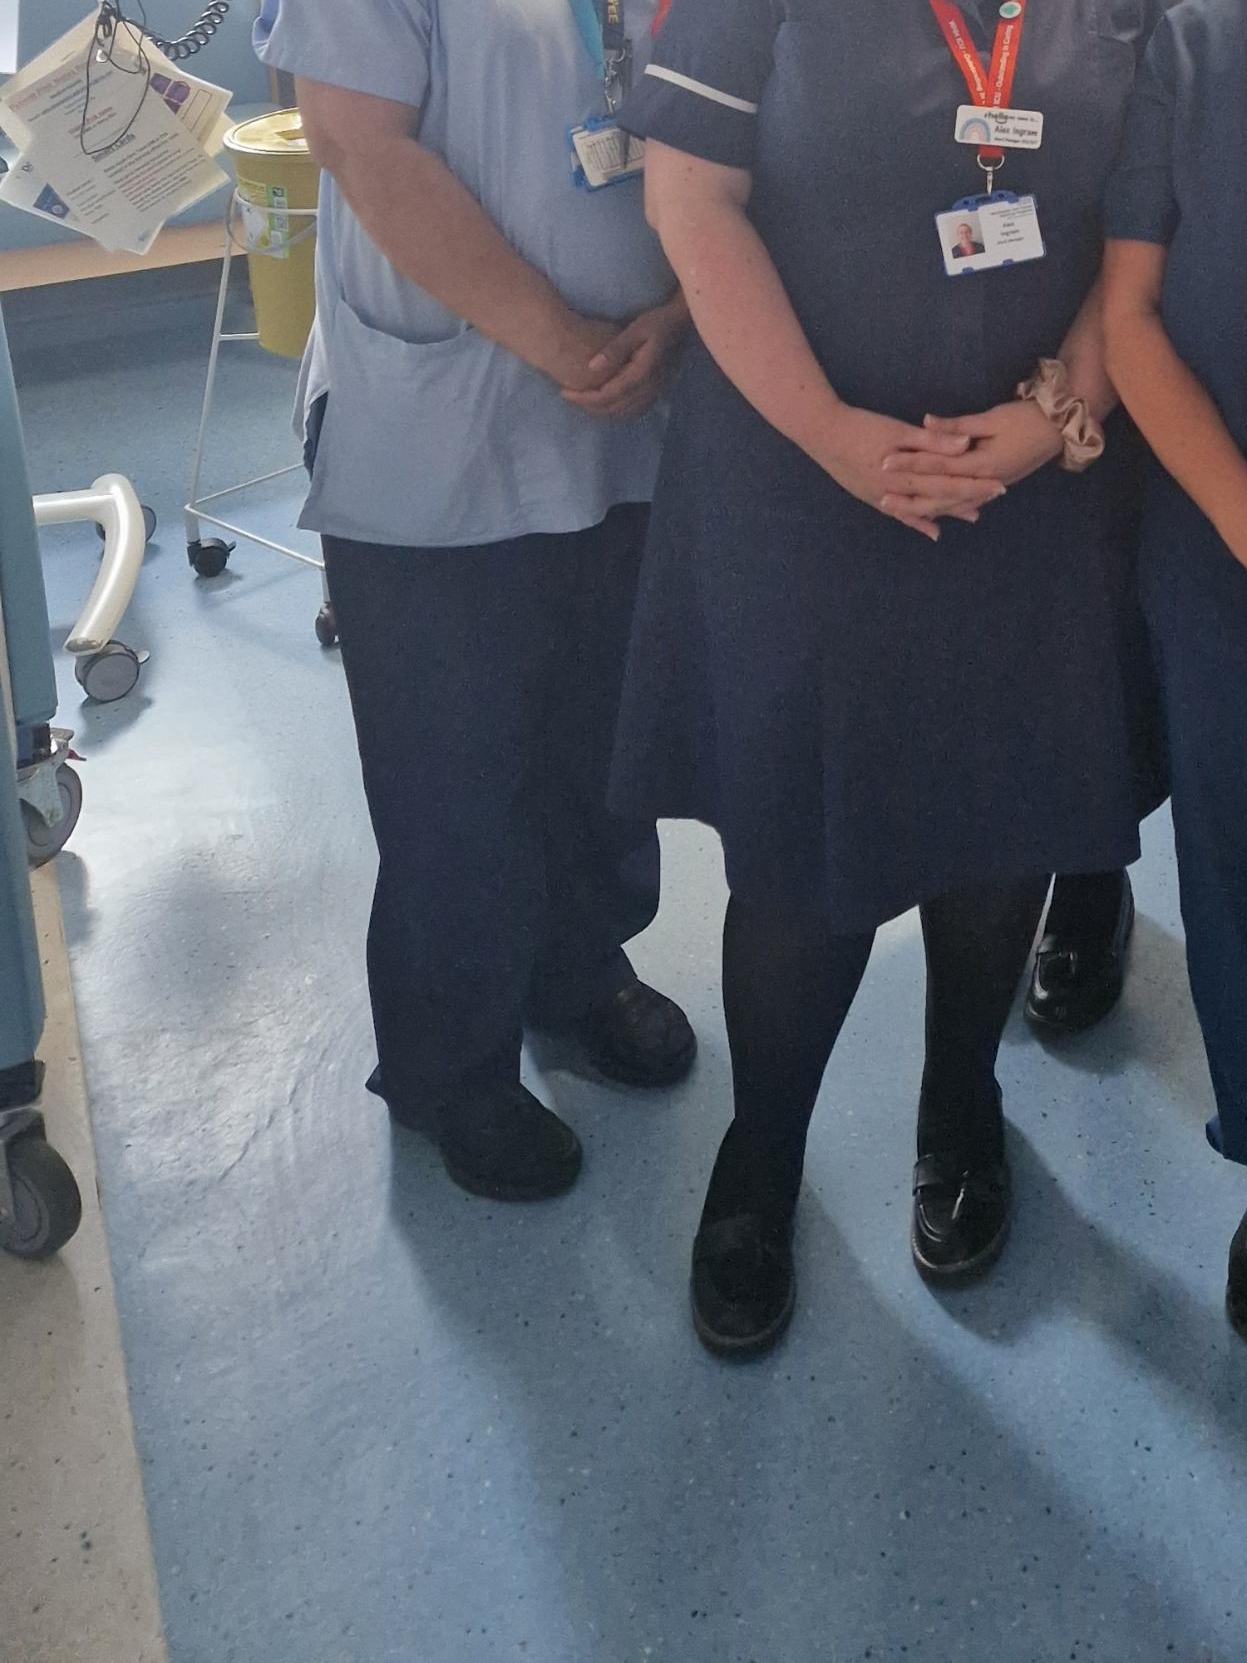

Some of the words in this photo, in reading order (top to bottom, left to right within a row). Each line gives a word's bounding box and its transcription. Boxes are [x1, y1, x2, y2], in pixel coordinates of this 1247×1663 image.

[1002, 24, 1014, 44] Caring
[955, 36, 965, 49] ICU
[963, 53, 983, 91] Outstanding
[995, 50, 1009, 87] Outstanding
[993, 92, 1001, 104] ICU
[1013, 128, 1038, 137] Ingram
